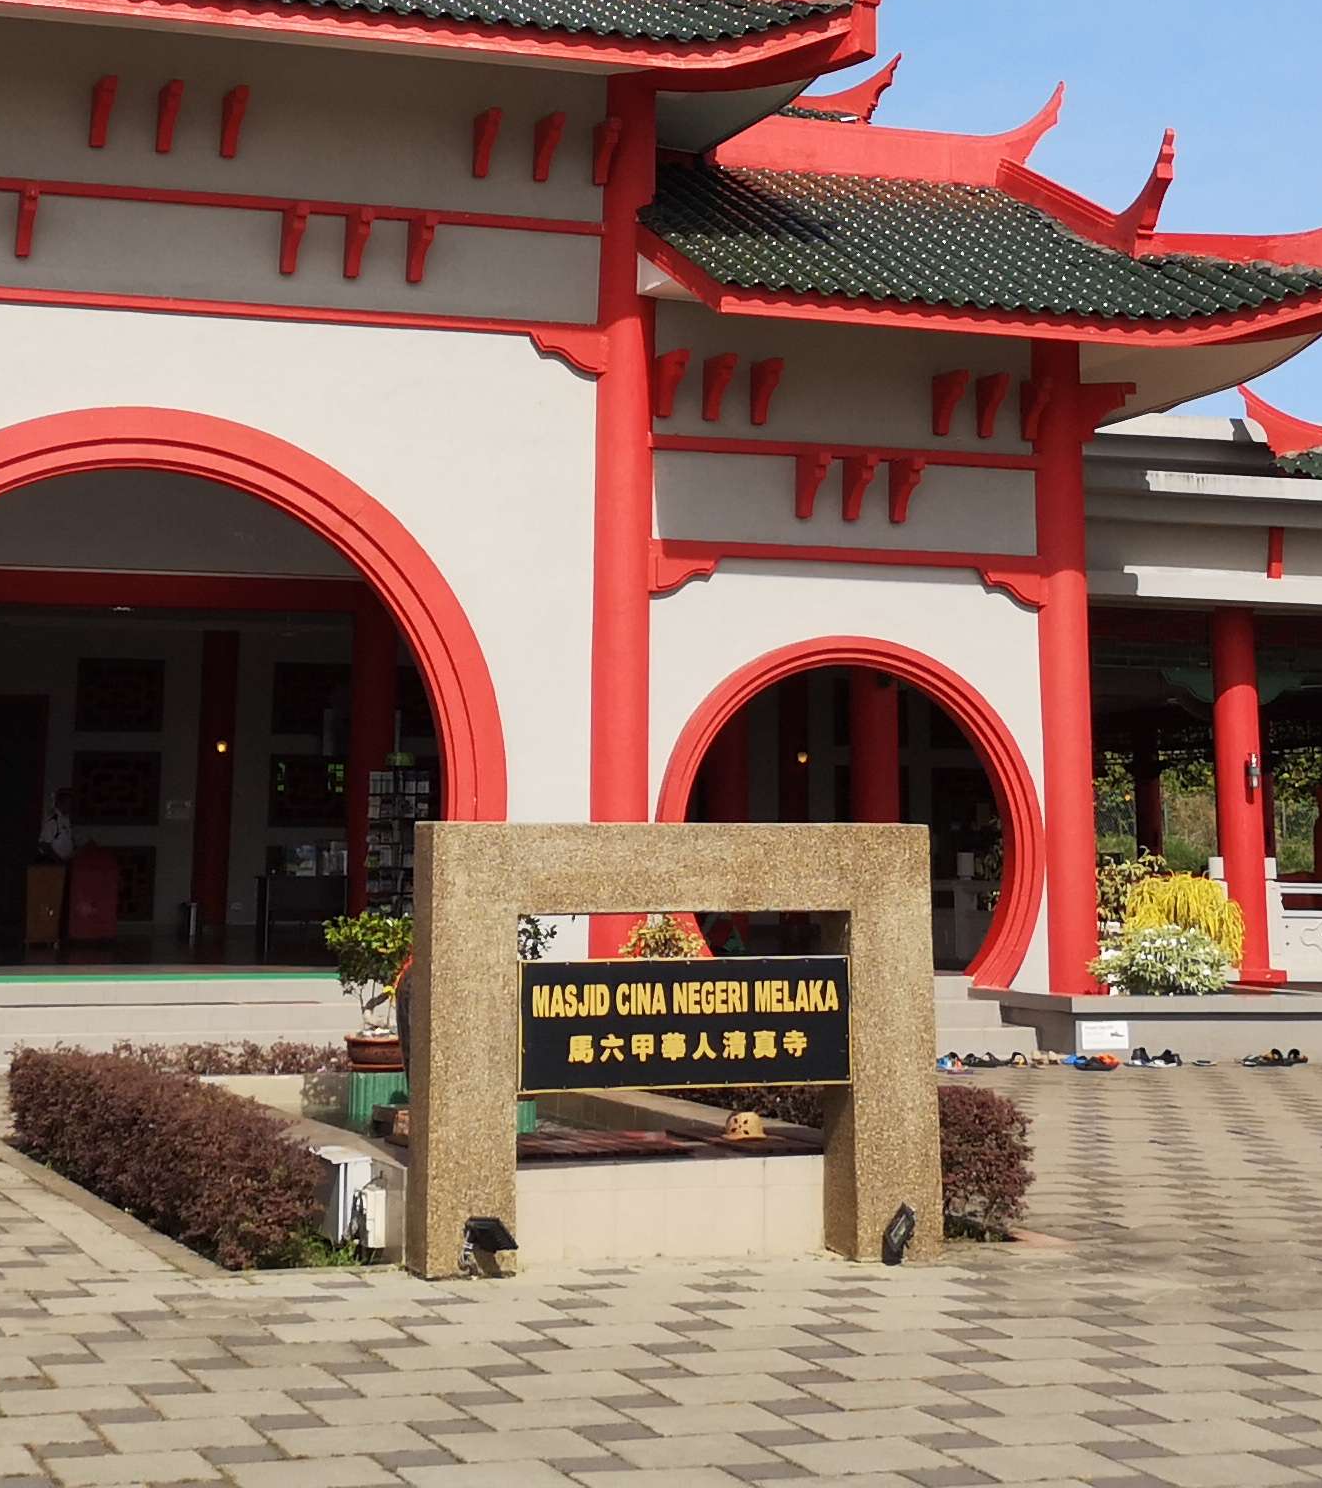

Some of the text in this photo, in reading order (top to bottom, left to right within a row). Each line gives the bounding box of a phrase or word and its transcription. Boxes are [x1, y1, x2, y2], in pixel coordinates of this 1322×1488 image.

[532, 980, 839, 1017] MASJID CINA NEGERI MELAKA
[568, 1030, 808, 1063] 馬六甲華人清真寺
